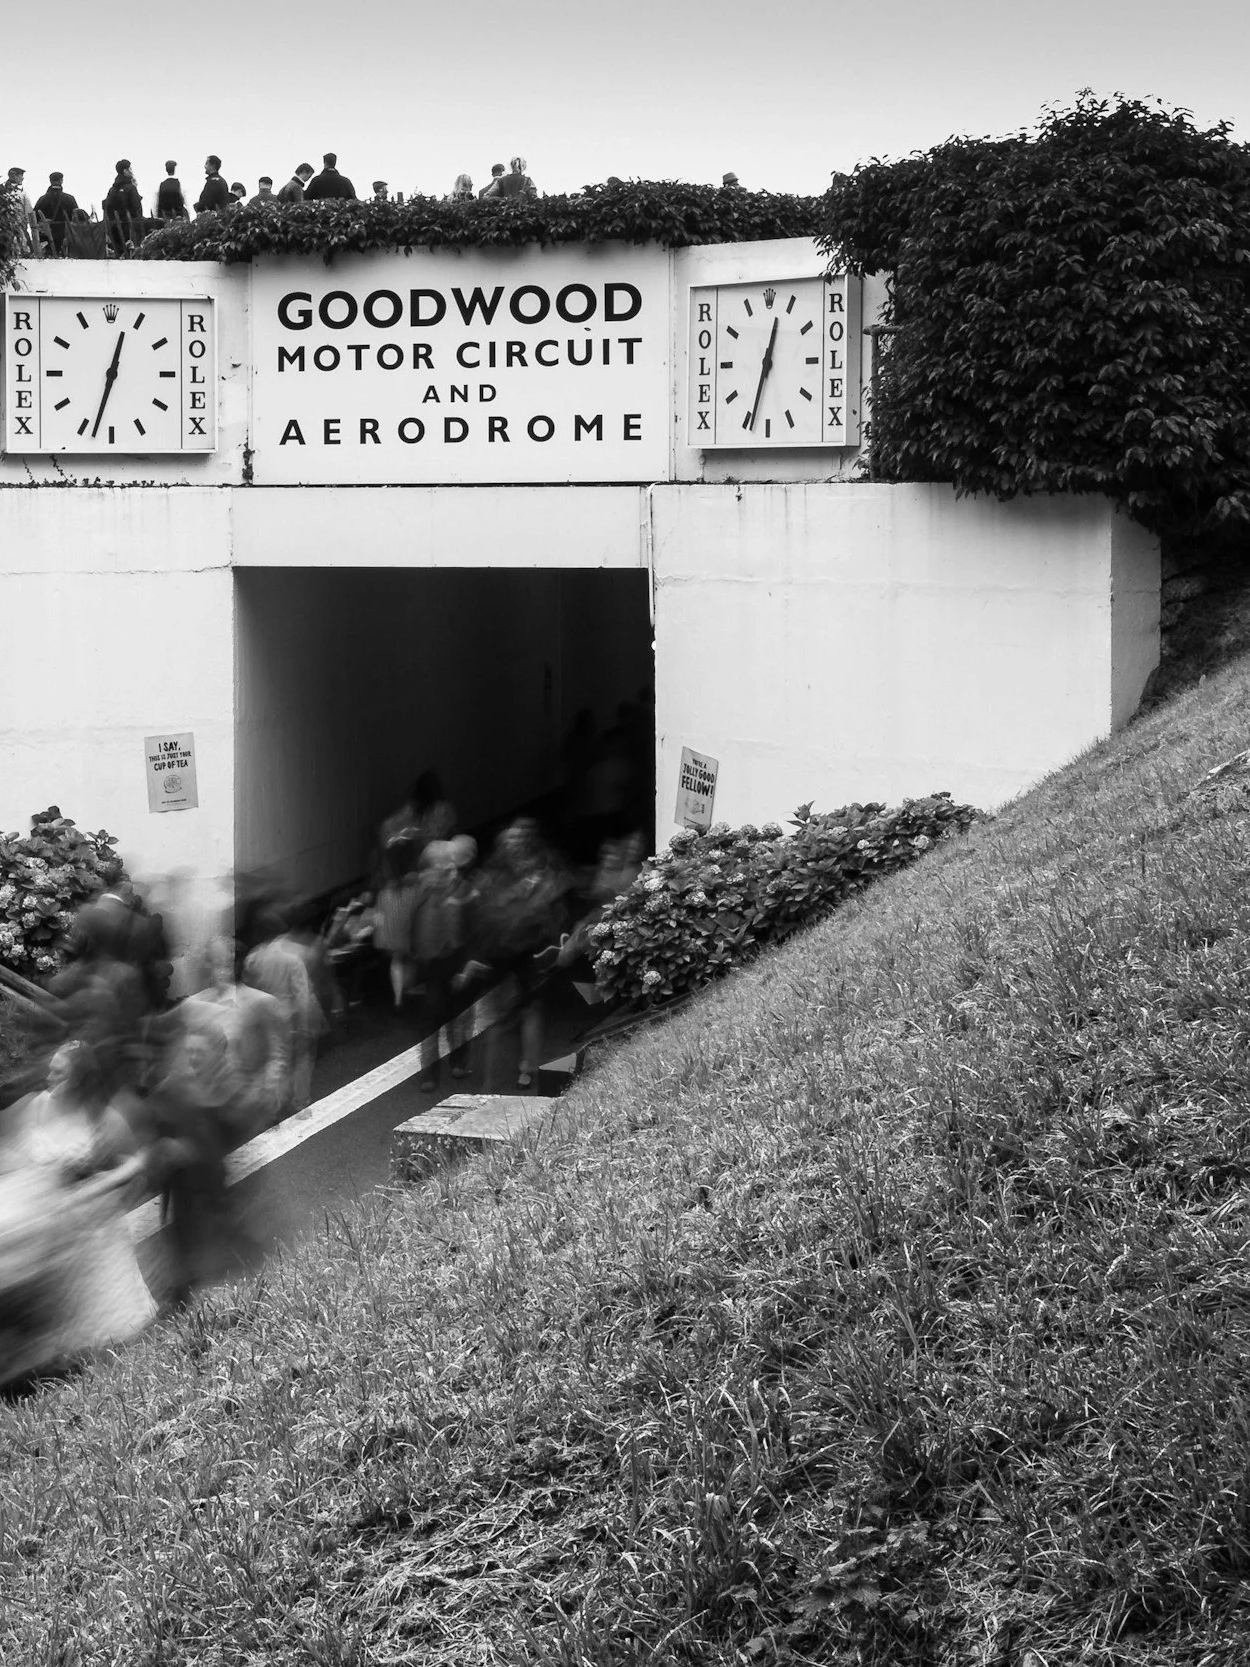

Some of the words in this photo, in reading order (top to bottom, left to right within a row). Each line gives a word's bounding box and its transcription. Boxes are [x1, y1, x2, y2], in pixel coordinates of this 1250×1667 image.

[277, 282, 643, 331] GOODWOOD
[277, 343, 435, 373] MOTOR
[456, 337, 643, 368] CIRCUIT
[697, 302, 712, 430] ROLEX
[828, 292, 845, 426] ROLEX
[13, 311, 34, 435] ROLEX
[187, 314, 207, 435] ROLEX
[422, 384, 497, 404] AND
[279, 413, 642, 446] AERODROME
[158, 743, 162, 753] I
[154, 762, 166, 771] CUP
[167, 761, 175, 769] OF
[177, 760, 189, 768] TEA
[683, 763, 699, 777] JOLLY
[699, 769, 714, 783] GOOD
[681, 775, 714, 798] FELLOW!
